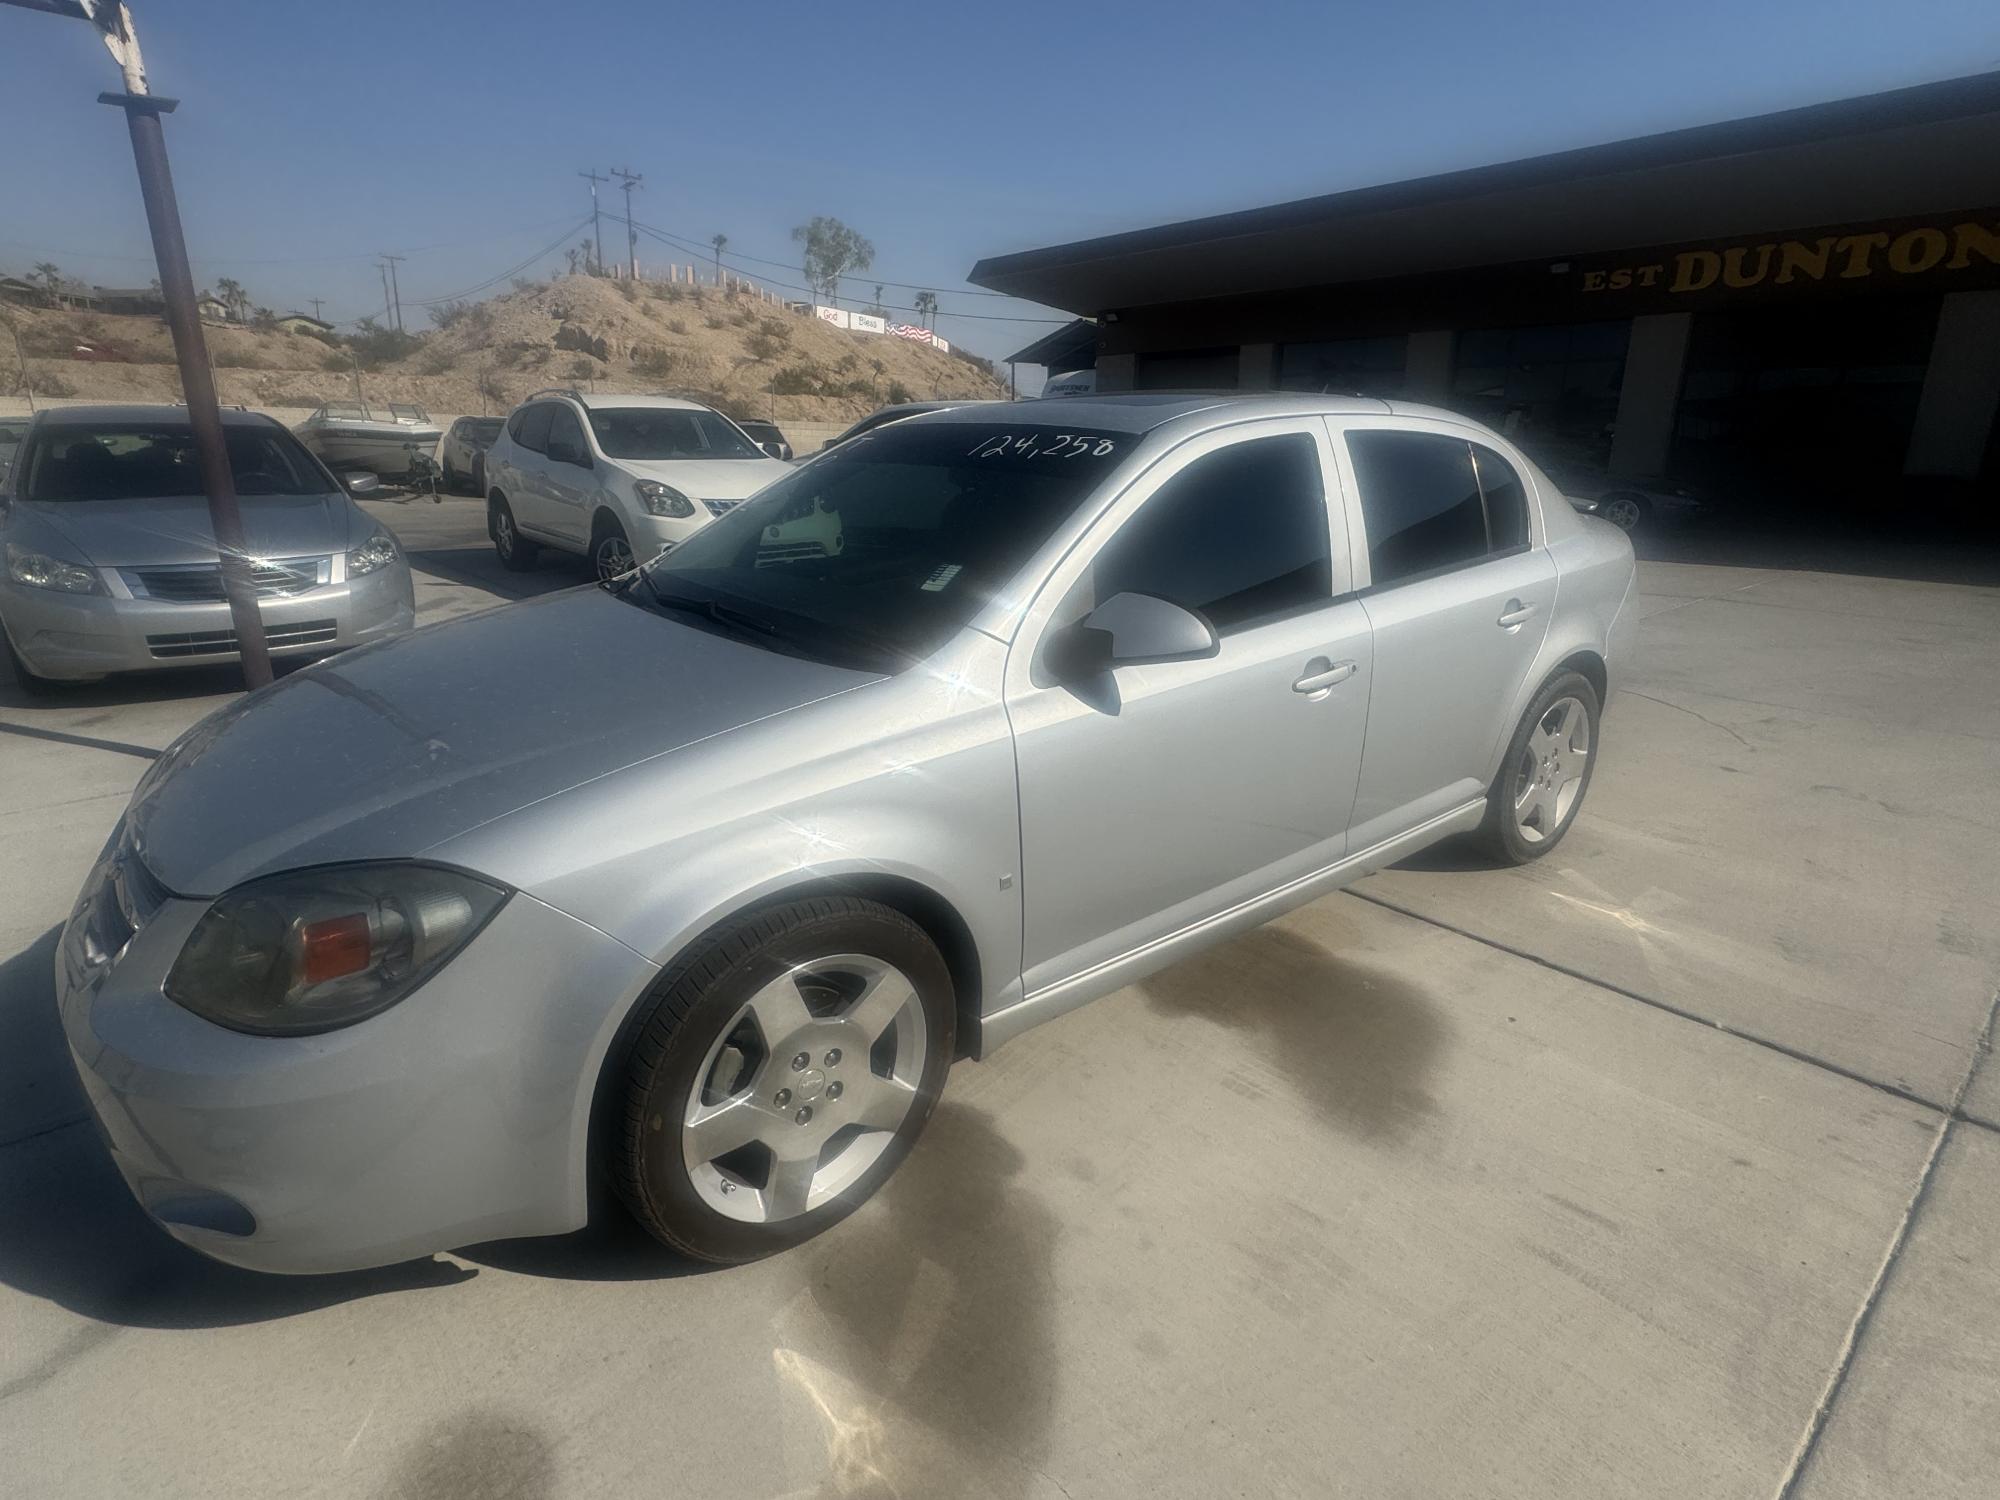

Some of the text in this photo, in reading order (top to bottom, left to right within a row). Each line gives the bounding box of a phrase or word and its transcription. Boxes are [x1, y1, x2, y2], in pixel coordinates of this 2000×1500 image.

[1582, 264, 1663, 292] EST
[823, 309, 838, 321] God
[967, 433, 1116, 459] 124,258
